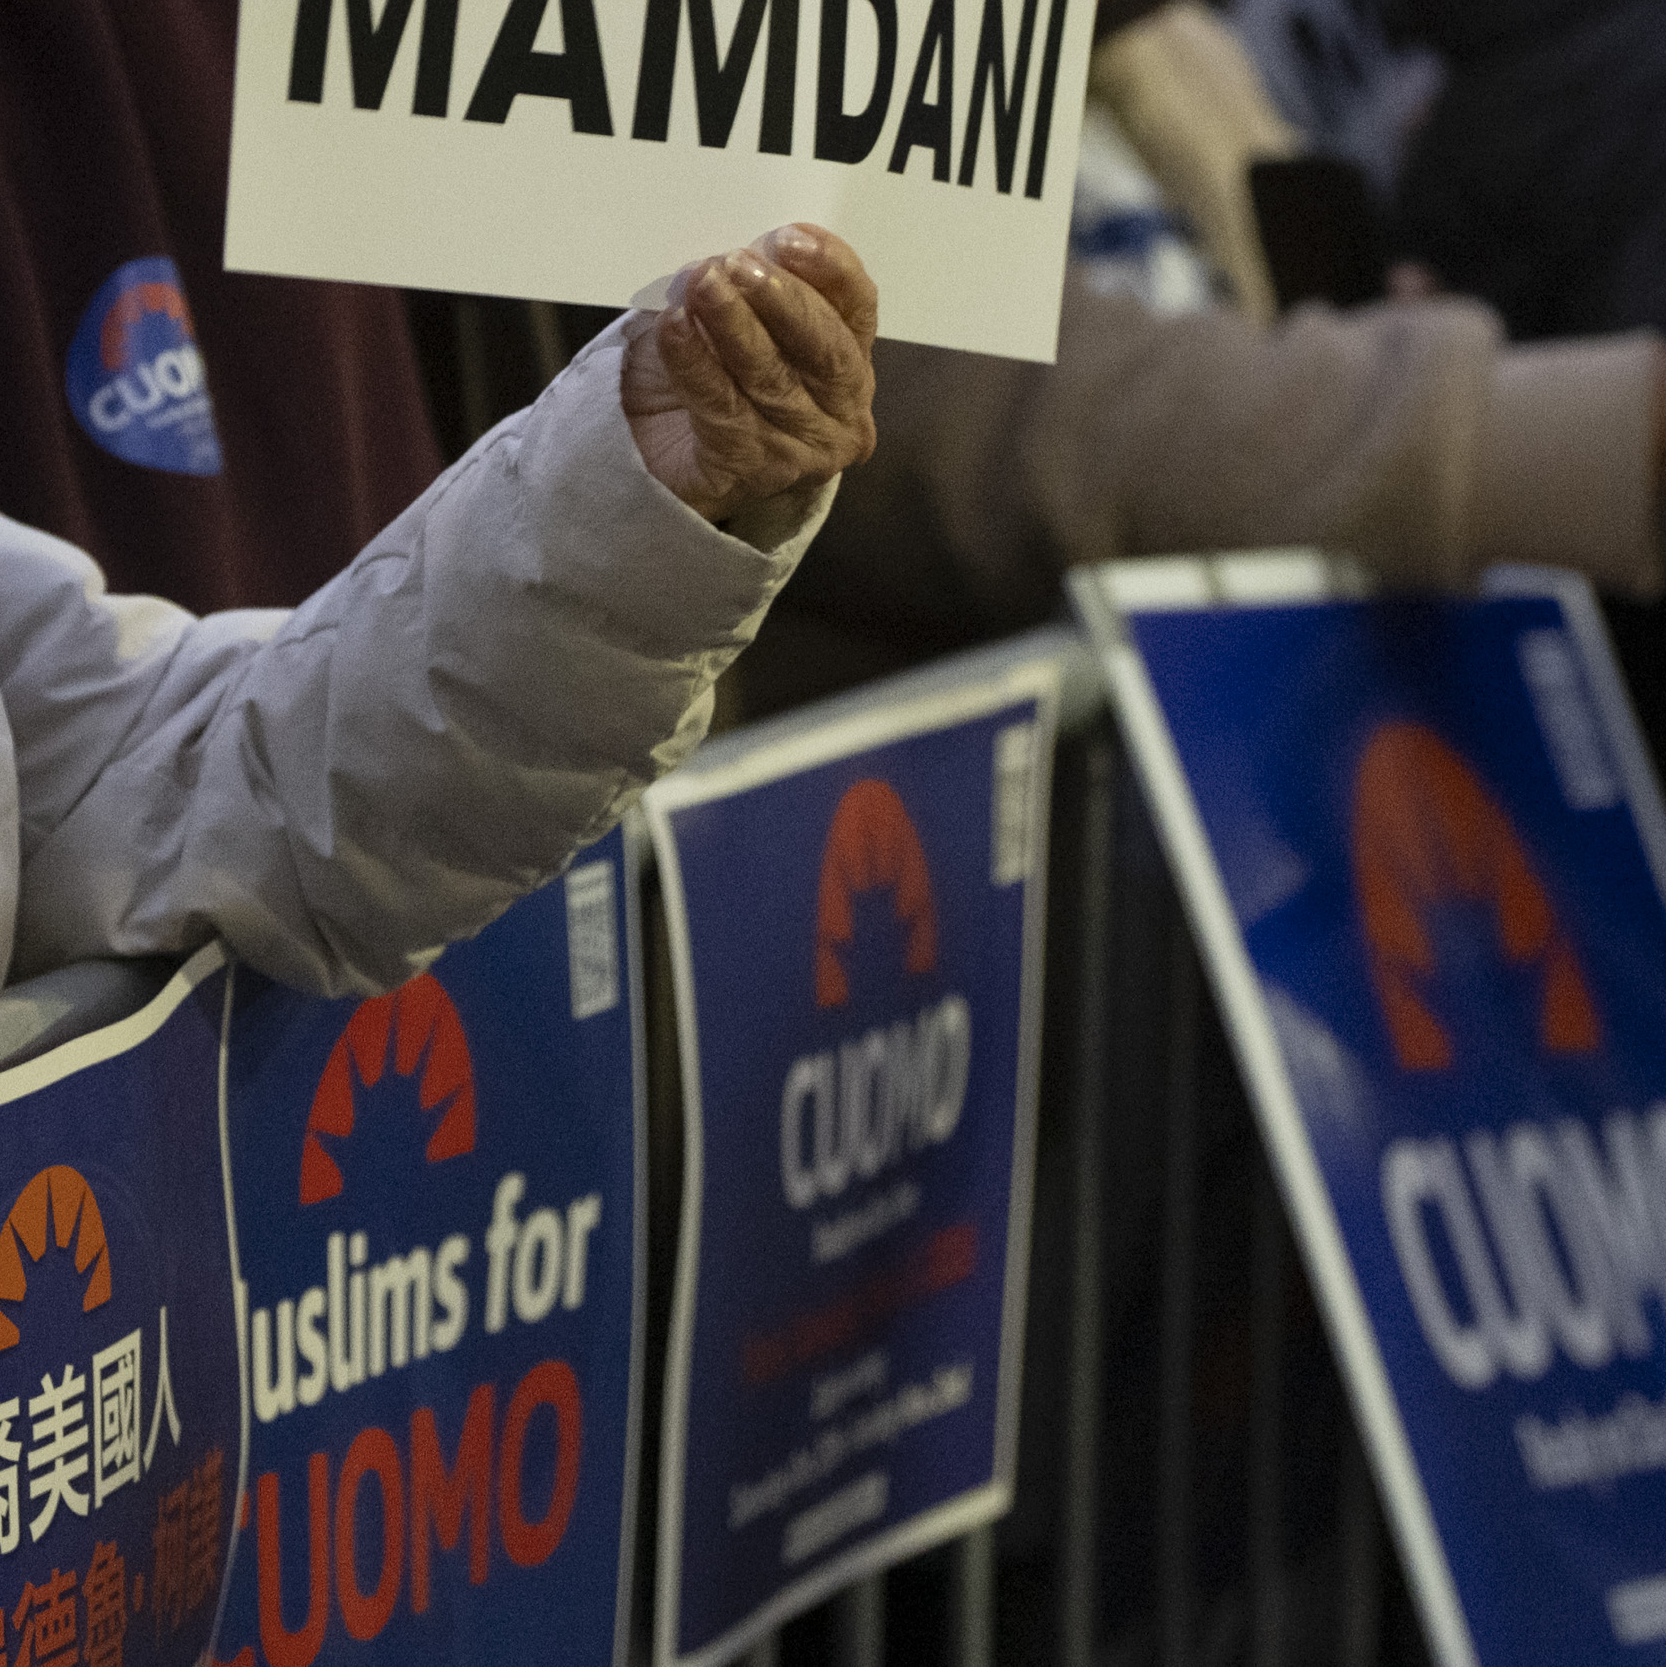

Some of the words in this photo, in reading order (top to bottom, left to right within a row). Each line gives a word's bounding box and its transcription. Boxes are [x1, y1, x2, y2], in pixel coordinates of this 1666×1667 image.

[89, 344, 206, 433] CUO
[781, 995, 971, 1209] CUOMO
[251, 1231, 471, 1423] uslims
[485, 1172, 602, 1334] for
[243, 1360, 583, 1667] UOMO
